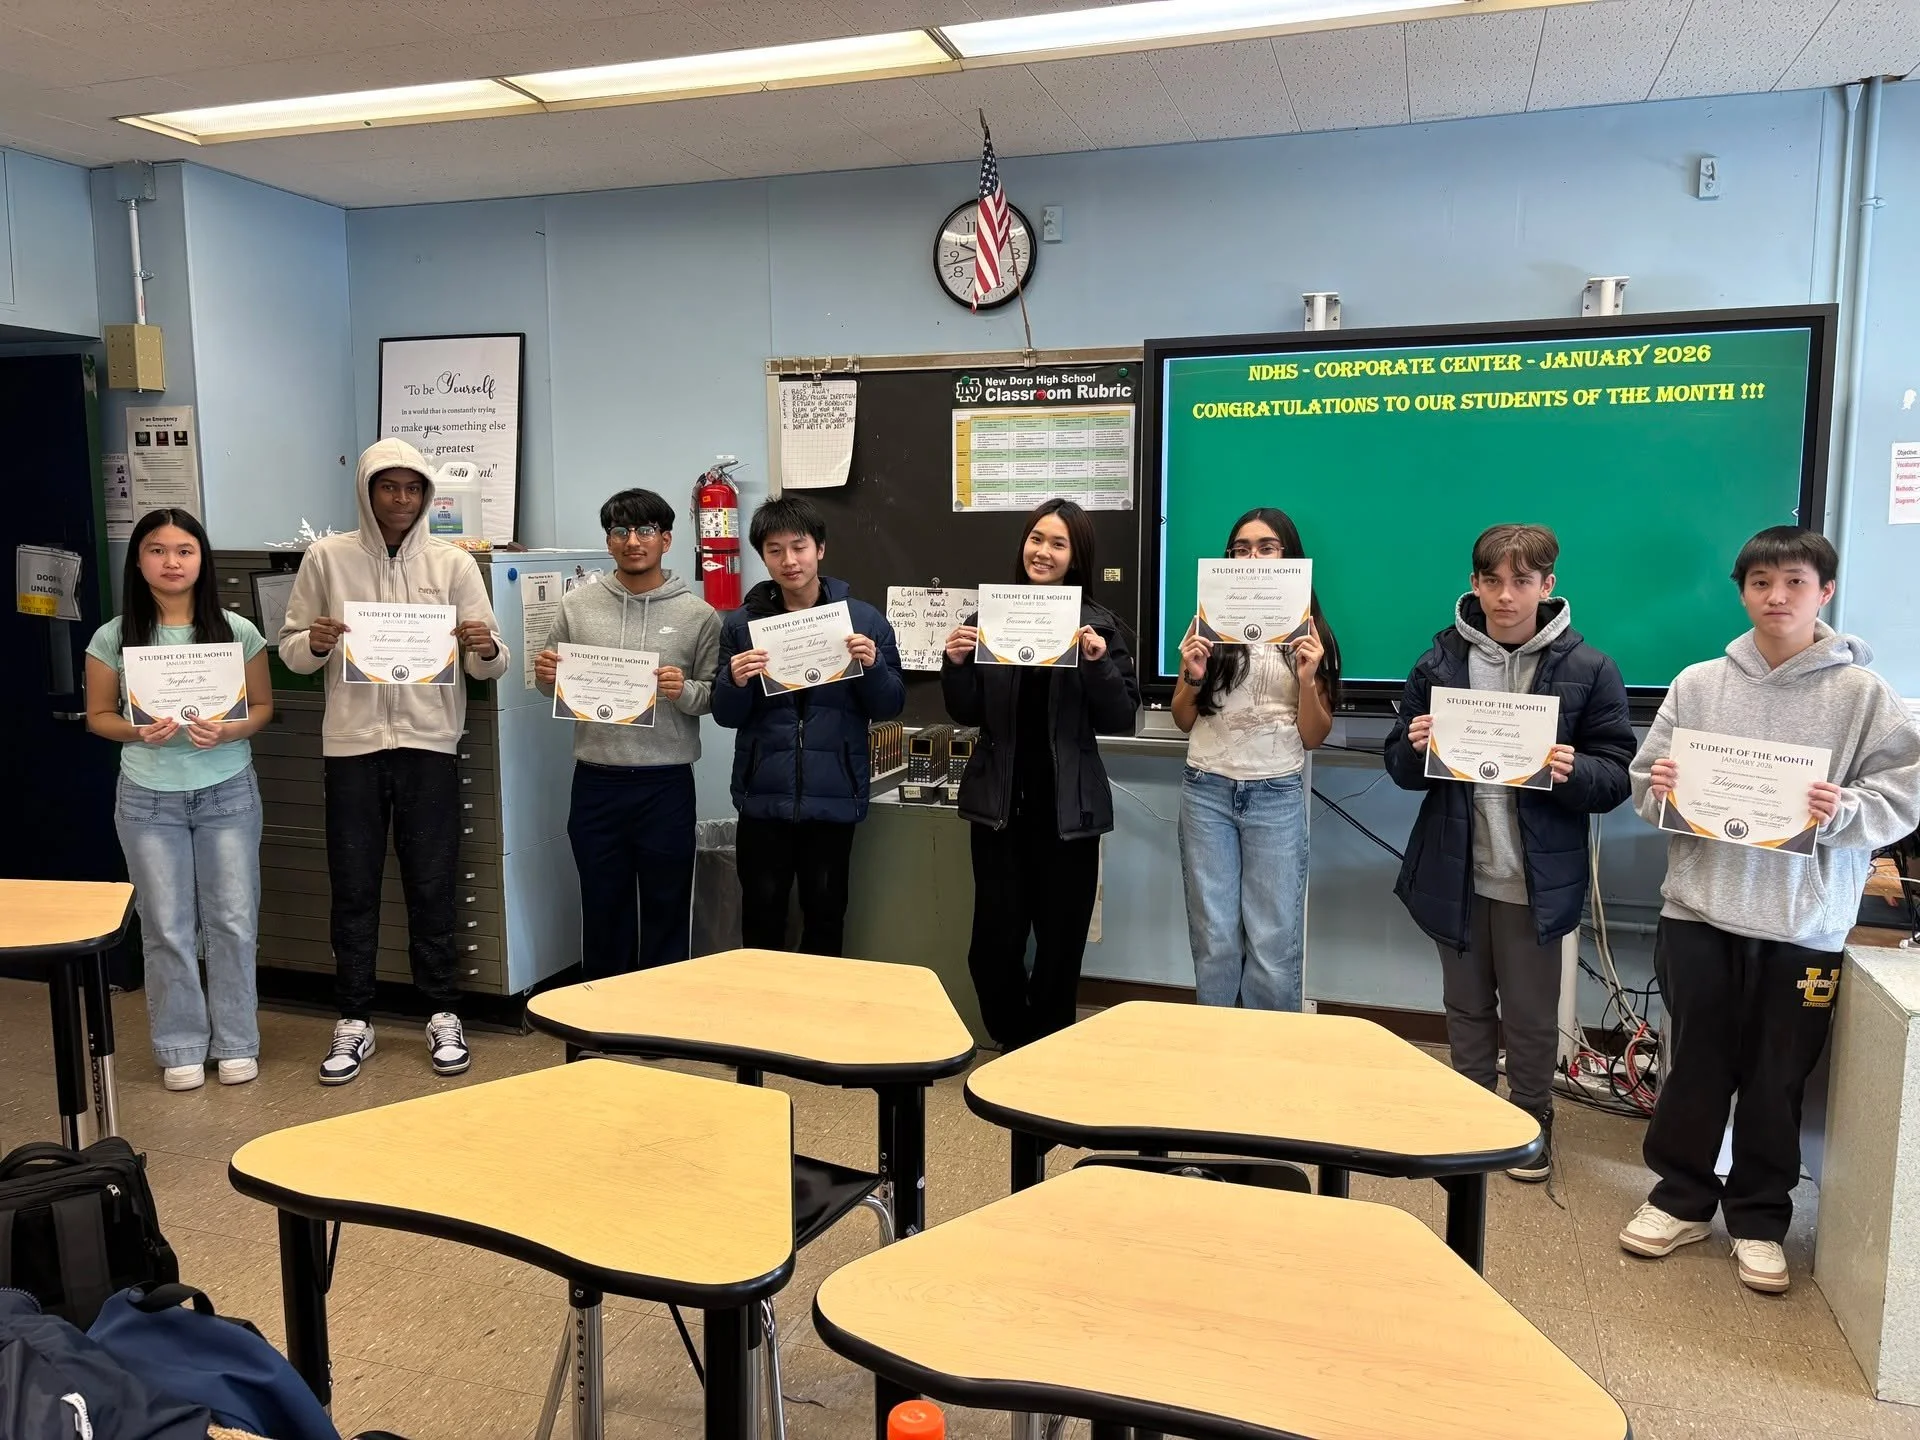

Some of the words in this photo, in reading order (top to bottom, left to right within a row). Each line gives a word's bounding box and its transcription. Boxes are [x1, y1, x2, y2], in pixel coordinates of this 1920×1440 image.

[966, 222, 975, 232] 11
[950, 251, 959, 263] 9
[1013, 248, 1020, 259] 3
[954, 266, 964, 277] 8
[1007, 265, 1016, 276] 4
[966, 277, 974, 289] 7
[1249, 360, 1298, 381] NDHS
[1313, 355, 1435, 378] CORPORATE
[1440, 352, 1522, 374] CENTER
[1540, 344, 1649, 370] JANUARY
[1654, 344, 1711, 365] 2026
[423, 384, 434, 395] be
[437, 371, 496, 400] Yourself
[985, 377, 1008, 386] New
[1010, 376, 1033, 387] Dorp
[1036, 375, 1058, 385] High
[1062, 373, 1096, 383] School
[1077, 384, 1131, 399] Rubric
[1193, 395, 1380, 419] CONGRATULATIONS
[1383, 394, 1409, 413] TO
[1415, 392, 1456, 412] OUR
[1461, 388, 1568, 410] STUDENTS
[1573, 388, 1600, 406] OF
[1606, 385, 1649, 404] THE
[1655, 383, 1734, 402] MONTH
[1741, 382, 1764, 400] !!!
[448, 407, 476, 415] constantly
[401, 424, 422, 432] make
[424, 424, 442, 438] you
[442, 421, 487, 433] something
[489, 422, 506, 430] else
[436, 445, 475, 456] greatest
[762, 622, 791, 632] STUDENT
[816, 611, 840, 621] MONTH
[570, 652, 599, 660] STUDENT
[564, 673, 593, 684] Anthony
[1446, 698, 1483, 707] STUDENT
[1515, 704, 1547, 712] MONTH
[1690, 742, 1734, 755] STUDENT
[1737, 749, 1750, 757] OF
[1752, 751, 1771, 761] THE
[1774, 755, 1814, 767] MONTH
[1721, 756, 1755, 767] JANUARY
[1756, 761, 1772, 769] 2026
